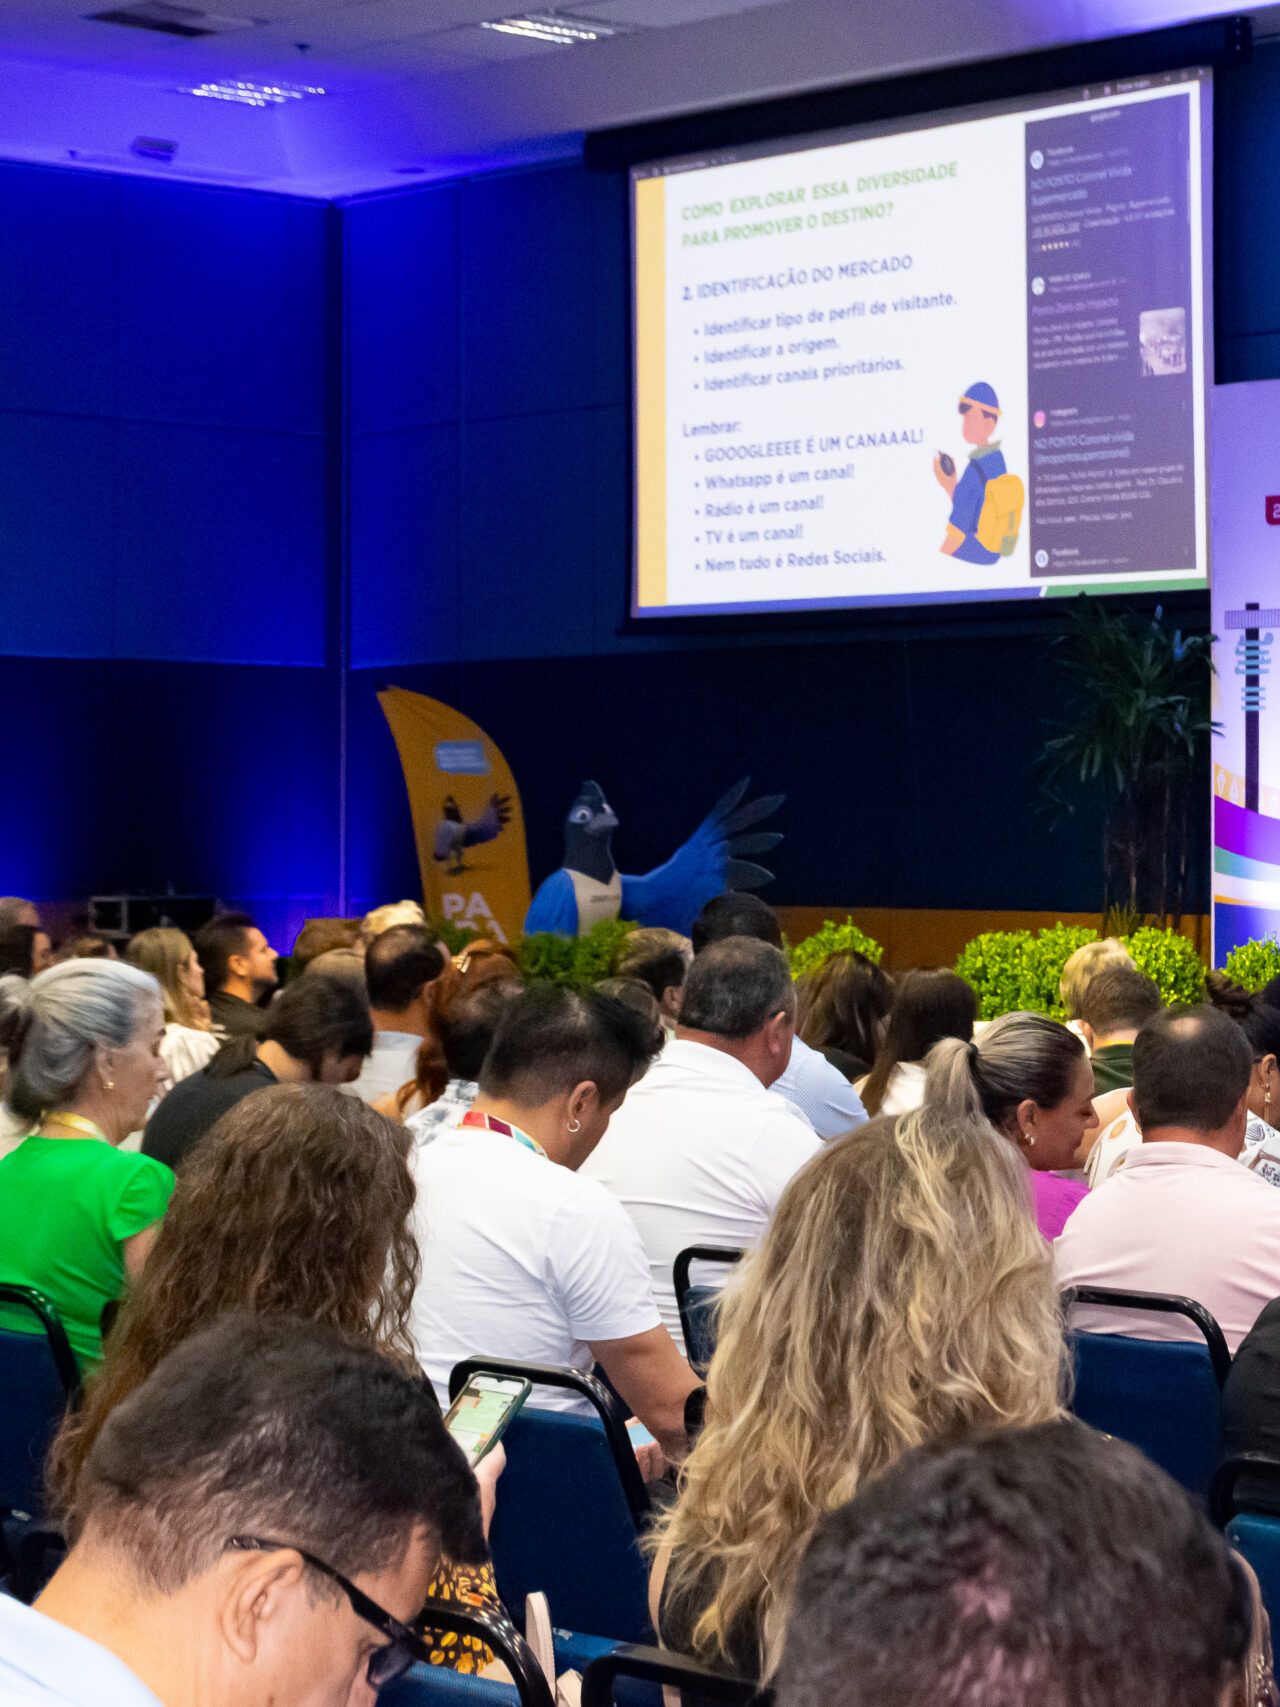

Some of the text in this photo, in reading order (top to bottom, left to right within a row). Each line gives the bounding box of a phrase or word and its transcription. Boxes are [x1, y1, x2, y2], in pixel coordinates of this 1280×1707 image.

[682, 161, 958, 221] COMO EXPLORAR ESSA DIVERSIDADE
[682, 202, 894, 249] PARA PROMOVER O DESTINO?
[682, 255, 913, 301] 2. IDENTIFICAÇÃO DO MERCADO
[704, 292, 958, 337] Identificar tipo de perfil de visitante.
[704, 336, 840, 364] Identificar a origem.
[704, 357, 905, 392] Identificar canais prioritários.
[682, 420, 742, 438] Lembrar:
[704, 429, 925, 463] GOOOGLEEEE É UM CANAAAL!
[704, 463, 855, 490] Whatsapp é um canal!
[704, 495, 824, 518] Rádio é um canal!
[705, 524, 803, 544] TV é um canal!
[705, 547, 887, 572] Nem tudo é Redes Sociais.
